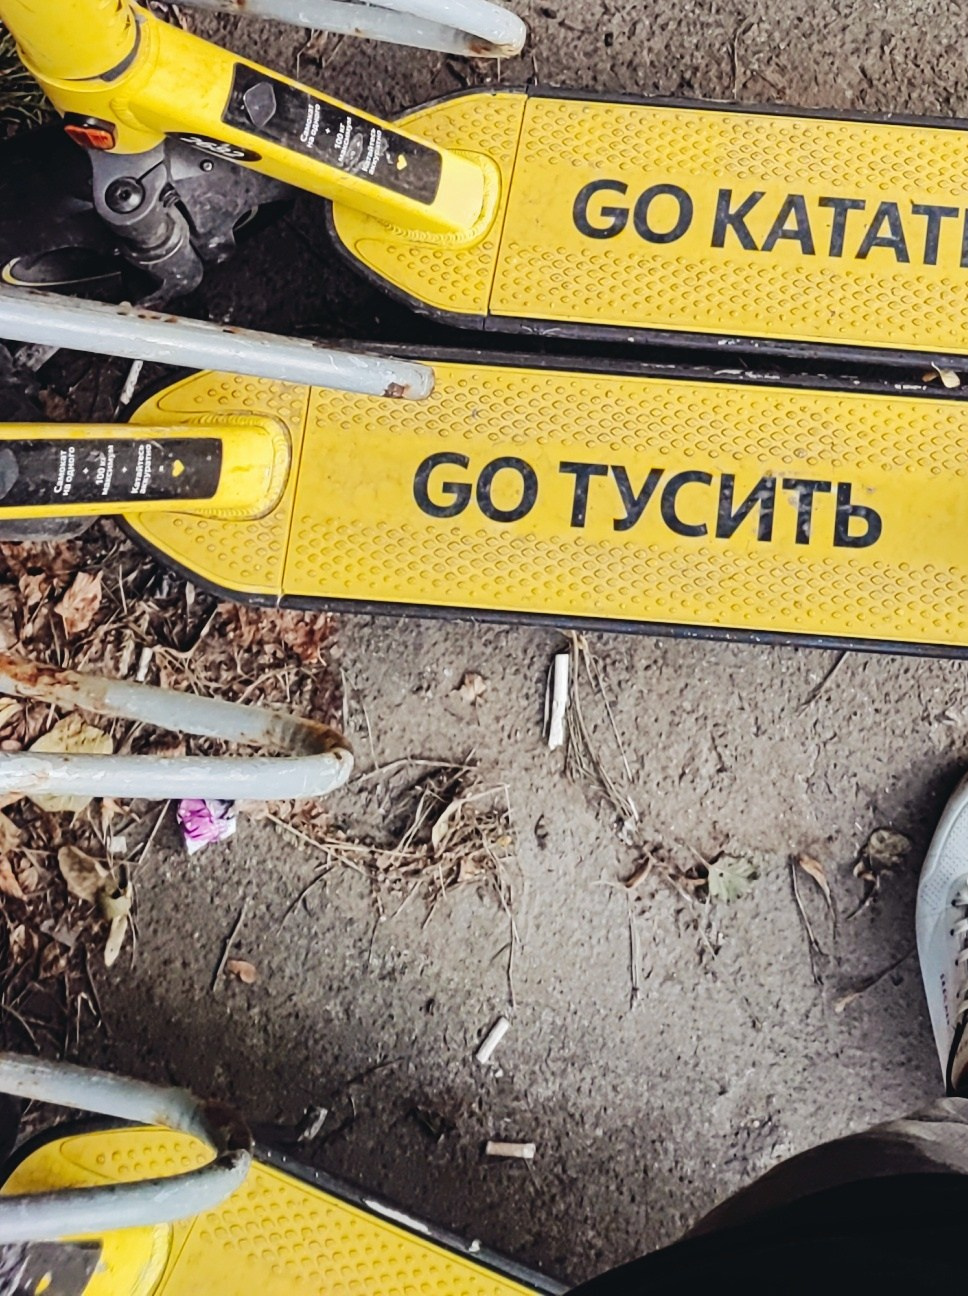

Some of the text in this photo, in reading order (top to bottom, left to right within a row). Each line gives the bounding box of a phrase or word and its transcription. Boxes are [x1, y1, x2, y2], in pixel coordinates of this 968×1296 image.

[334, 133, 344, 149] 100
[573, 180, 694, 244] GO
[53, 450, 67, 494] Самокат
[65, 446, 76, 483] одного
[95, 467, 106, 485] 100
[130, 444, 145, 494] Катайтесь
[414, 451, 883, 549] GO ТУСИТЬ
